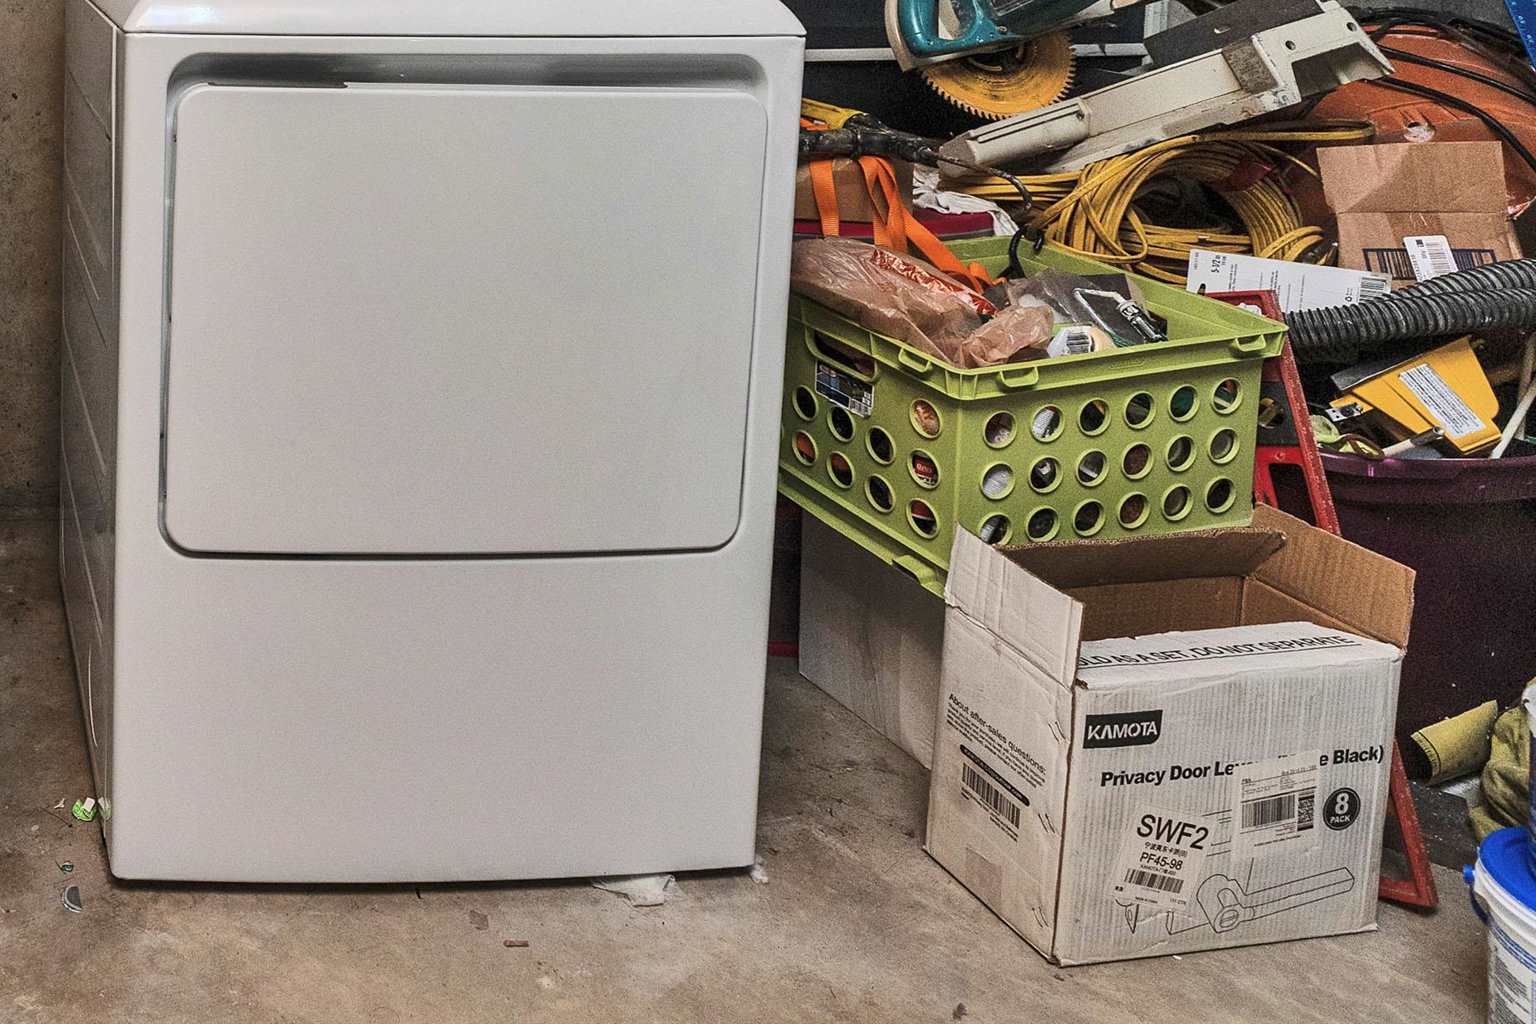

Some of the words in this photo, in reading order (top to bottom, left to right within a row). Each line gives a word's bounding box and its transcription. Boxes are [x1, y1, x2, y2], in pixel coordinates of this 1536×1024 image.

[1217, 643, 1264, 654] NOT
[1258, 635, 1355, 651] SEPARATE
[1087, 720, 1159, 741] KAMOTA
[1100, 769, 1166, 787] Privacy
[1169, 765, 1211, 781] Door
[1332, 744, 1384, 765] Black)
[1334, 792, 1350, 815] 8
[1329, 815, 1352, 824] PACK
[1136, 813, 1209, 851] SWF2
[1139, 851, 1184, 871] PF45-98
